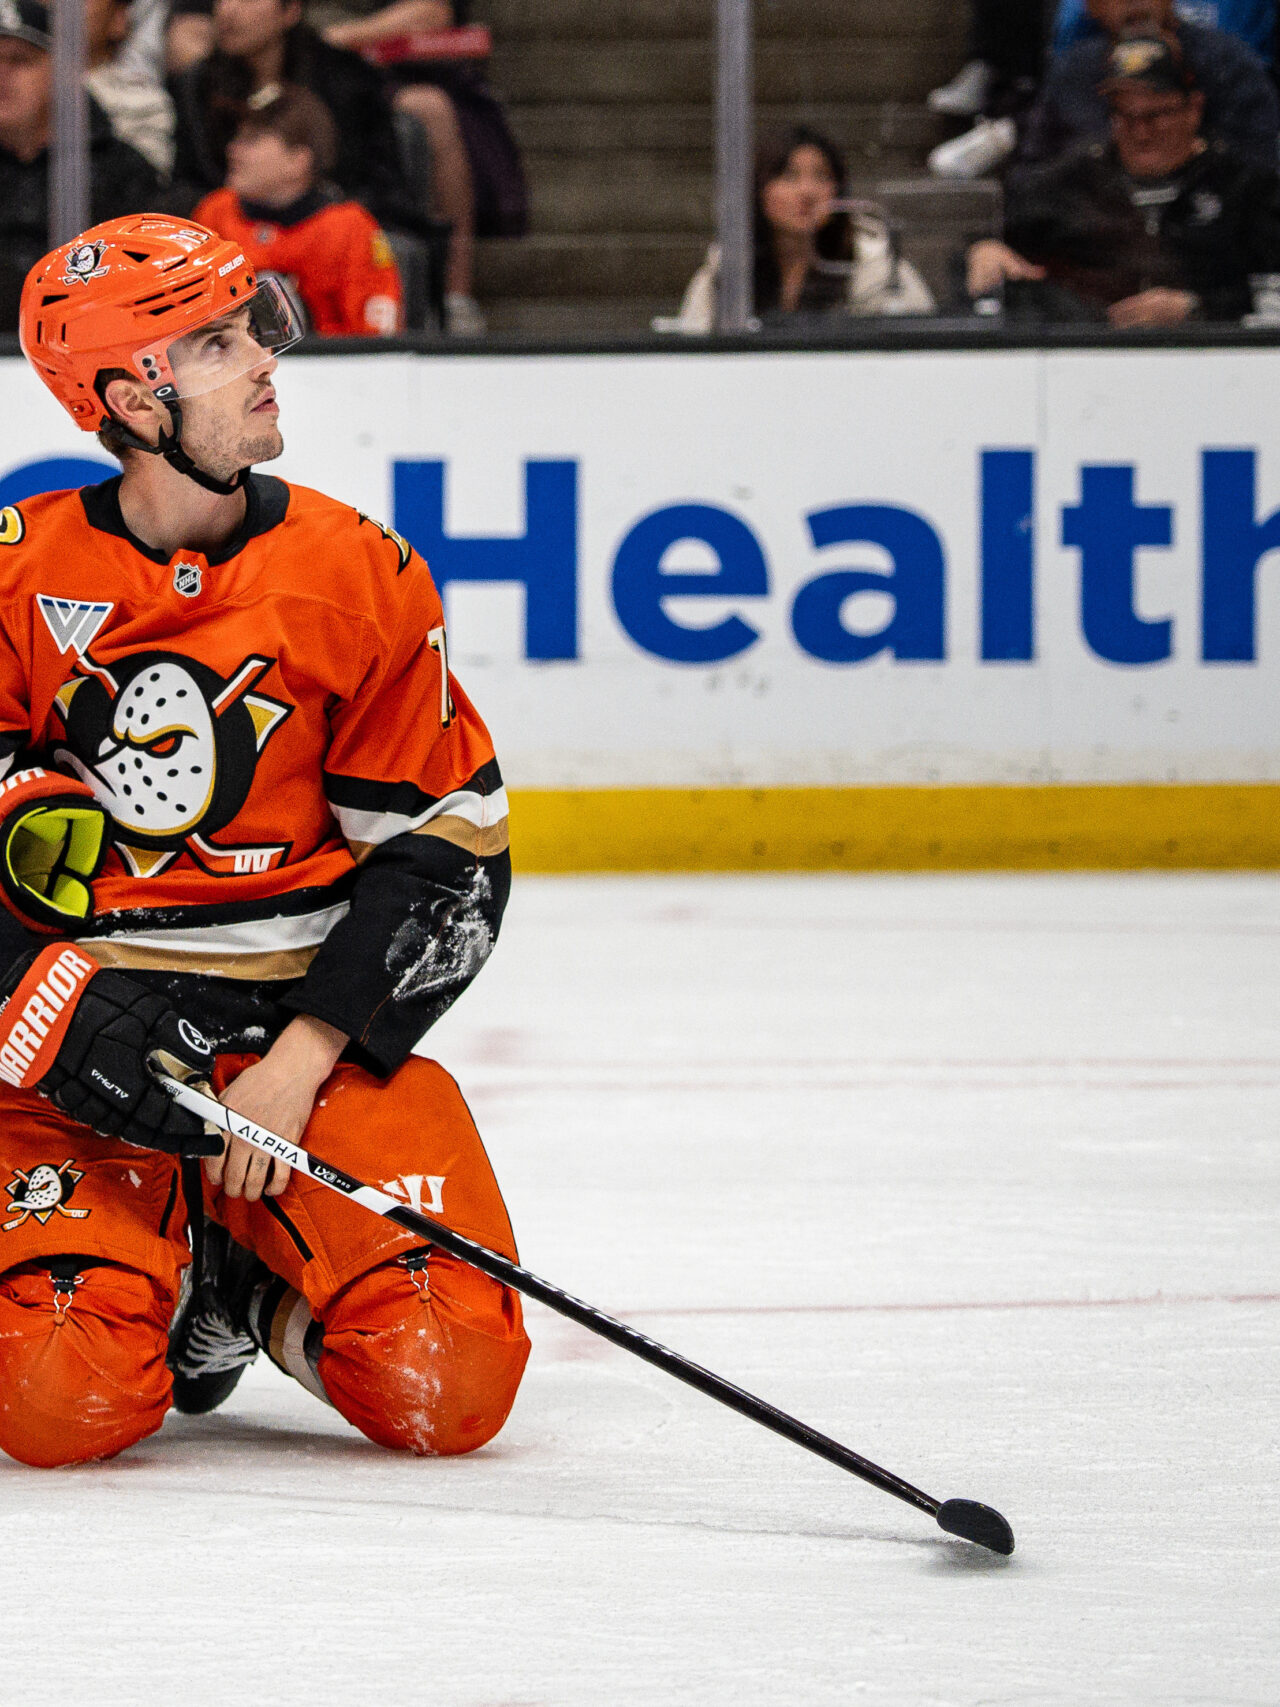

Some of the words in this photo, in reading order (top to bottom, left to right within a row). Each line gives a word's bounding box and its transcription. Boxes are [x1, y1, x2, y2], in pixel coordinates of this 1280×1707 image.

[179, 572, 197, 589] NHL
[426, 625, 457, 729] 1
[91, 1068, 129, 1099] ALPHA
[237, 1125, 299, 1164] ALPHA
